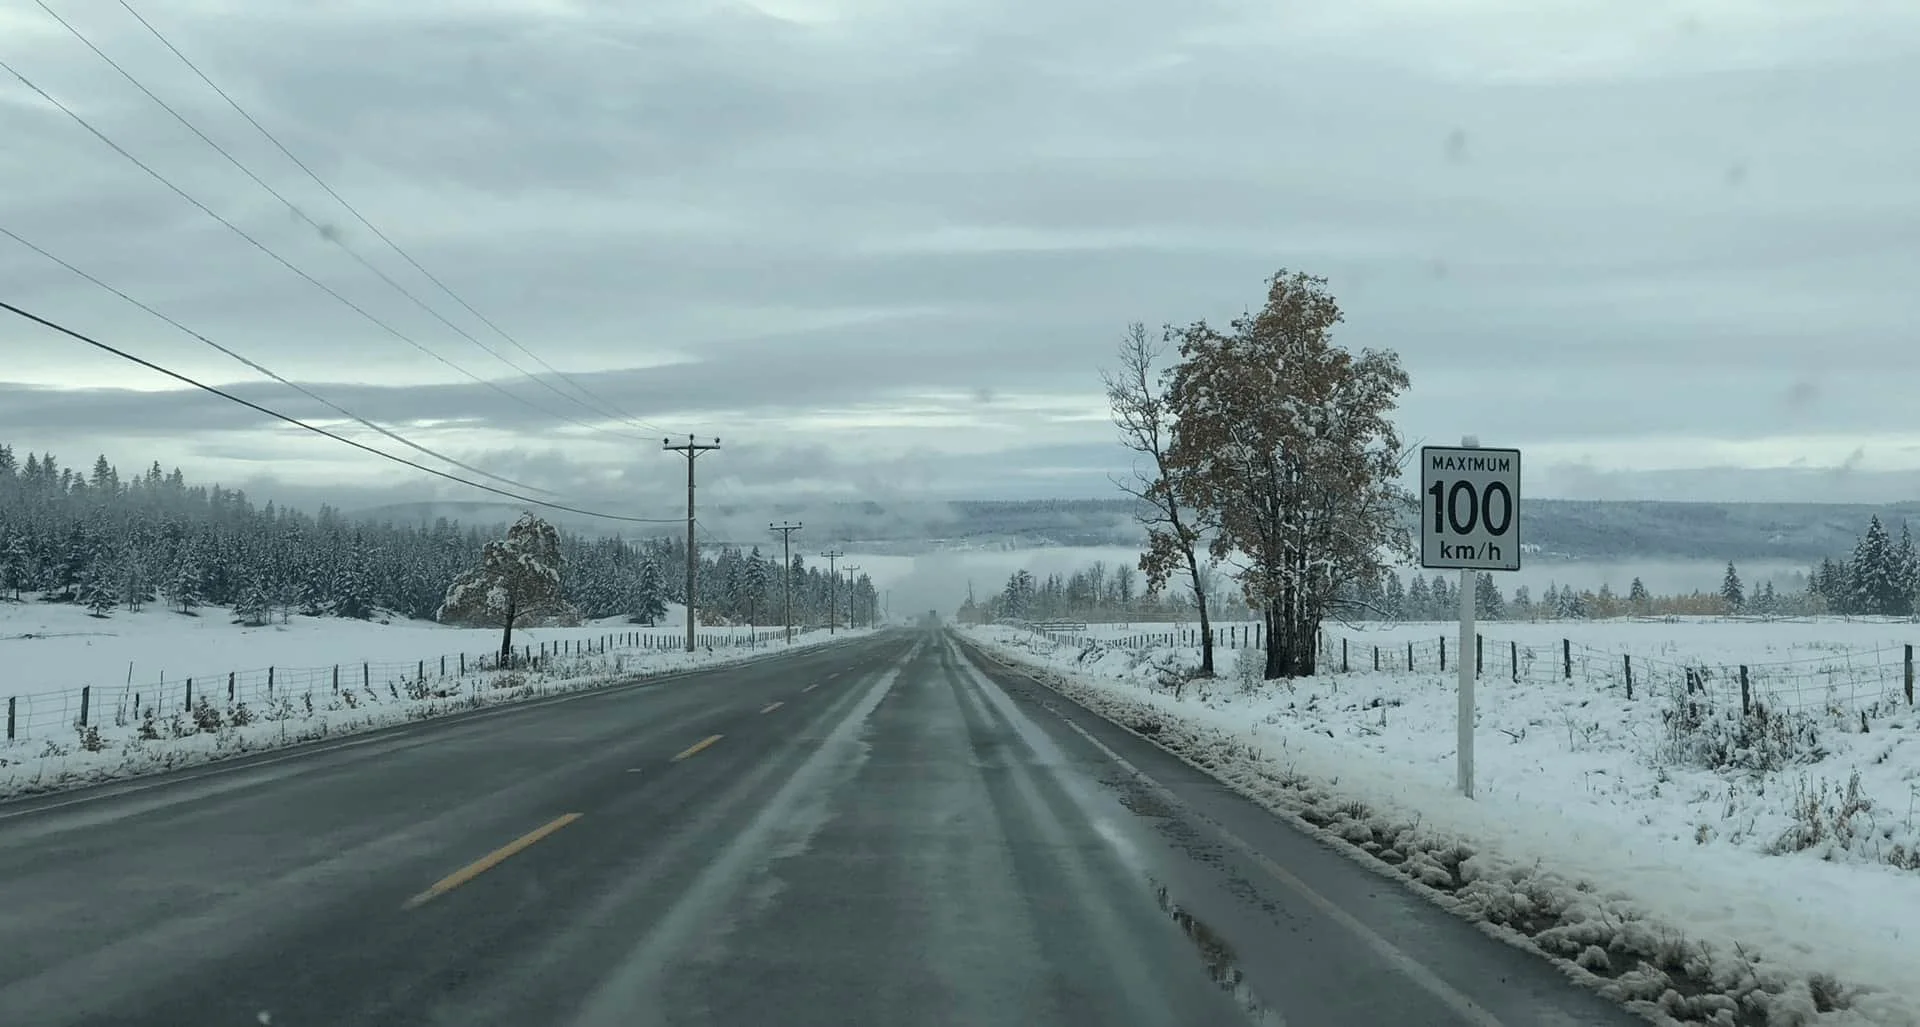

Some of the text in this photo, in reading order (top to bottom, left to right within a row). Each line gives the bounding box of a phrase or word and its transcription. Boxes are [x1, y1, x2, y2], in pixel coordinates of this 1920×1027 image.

[1432, 455, 1509, 473] MAXIMUM
[1428, 480, 1512, 536] 100
[1440, 540, 1501, 561] km/h
